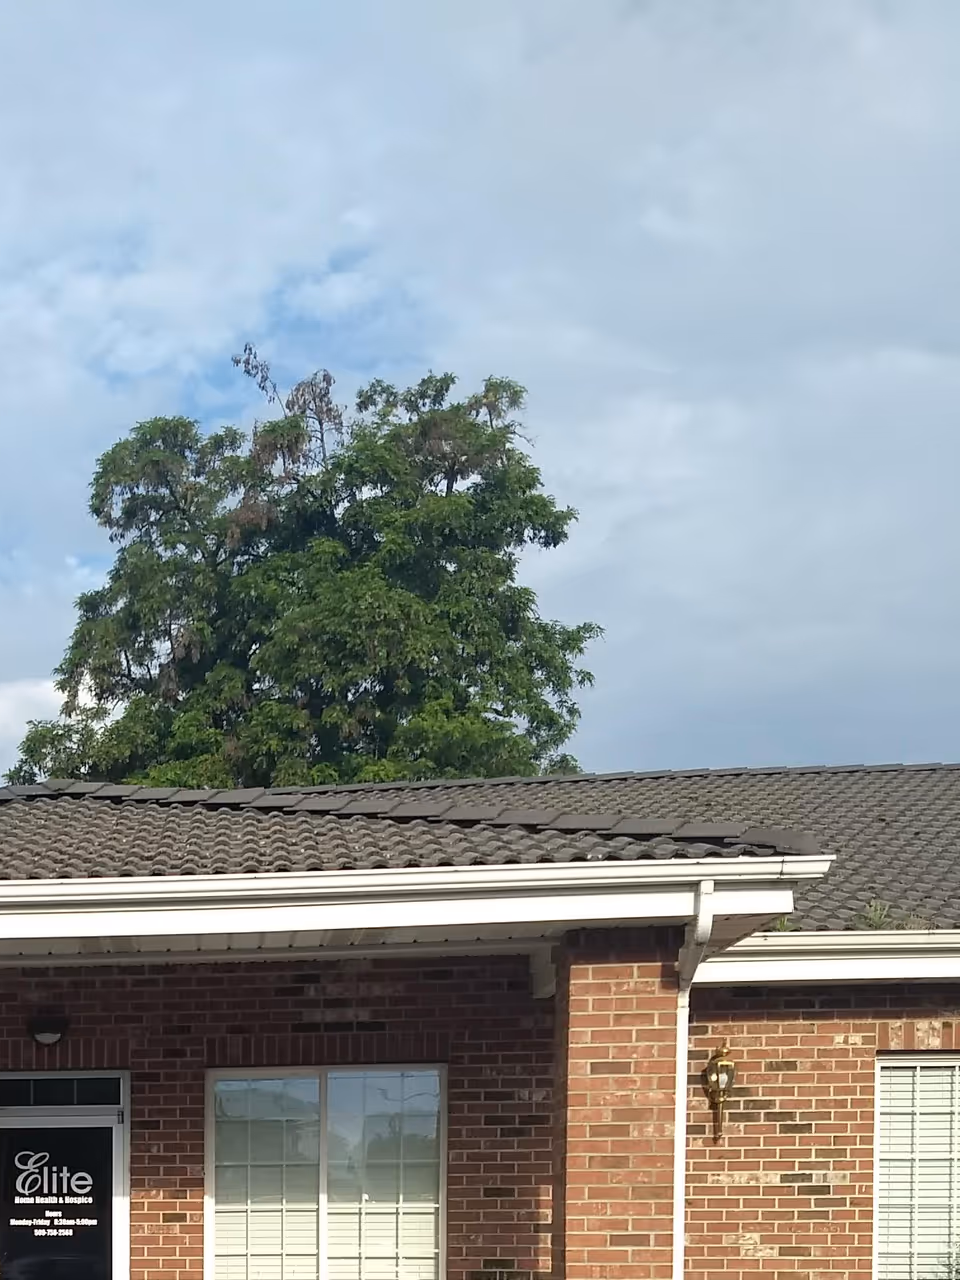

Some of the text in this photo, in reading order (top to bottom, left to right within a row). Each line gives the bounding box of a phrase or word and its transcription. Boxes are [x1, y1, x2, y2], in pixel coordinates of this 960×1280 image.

[14, 1151, 93, 1196] Elite
[14, 1196, 93, 1205] Home Health & Hospice
